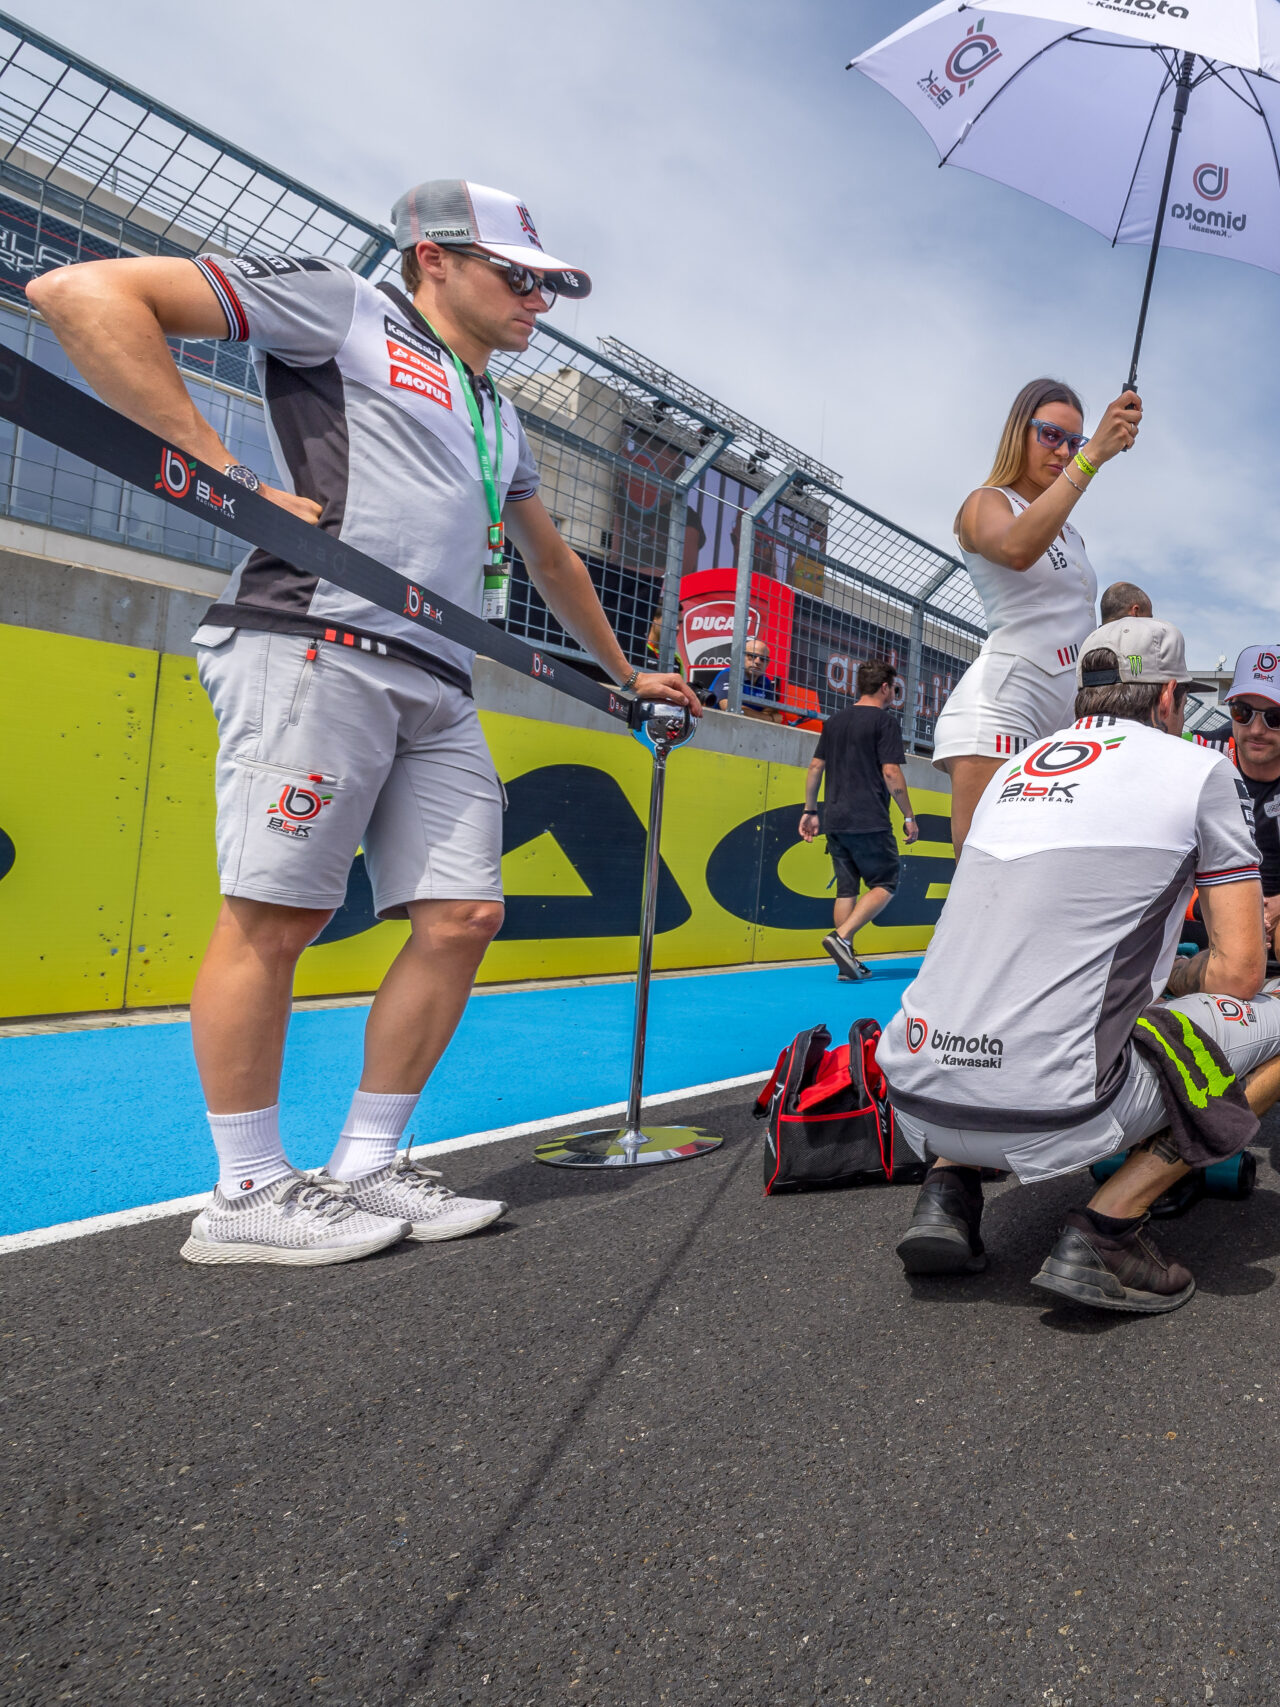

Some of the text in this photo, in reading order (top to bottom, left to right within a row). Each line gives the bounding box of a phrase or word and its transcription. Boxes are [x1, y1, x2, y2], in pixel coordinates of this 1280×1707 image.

[1096, 1, 1156, 20] Kawasaki
[425, 229, 469, 238] Kawasaki
[387, 322, 438, 361] Kawasaki
[395, 372, 449, 404] MOTUL
[691, 616, 752, 630] DUCAI
[931, 1029, 1004, 1055] bimota
[941, 1054, 1002, 1069] Kawasaki
